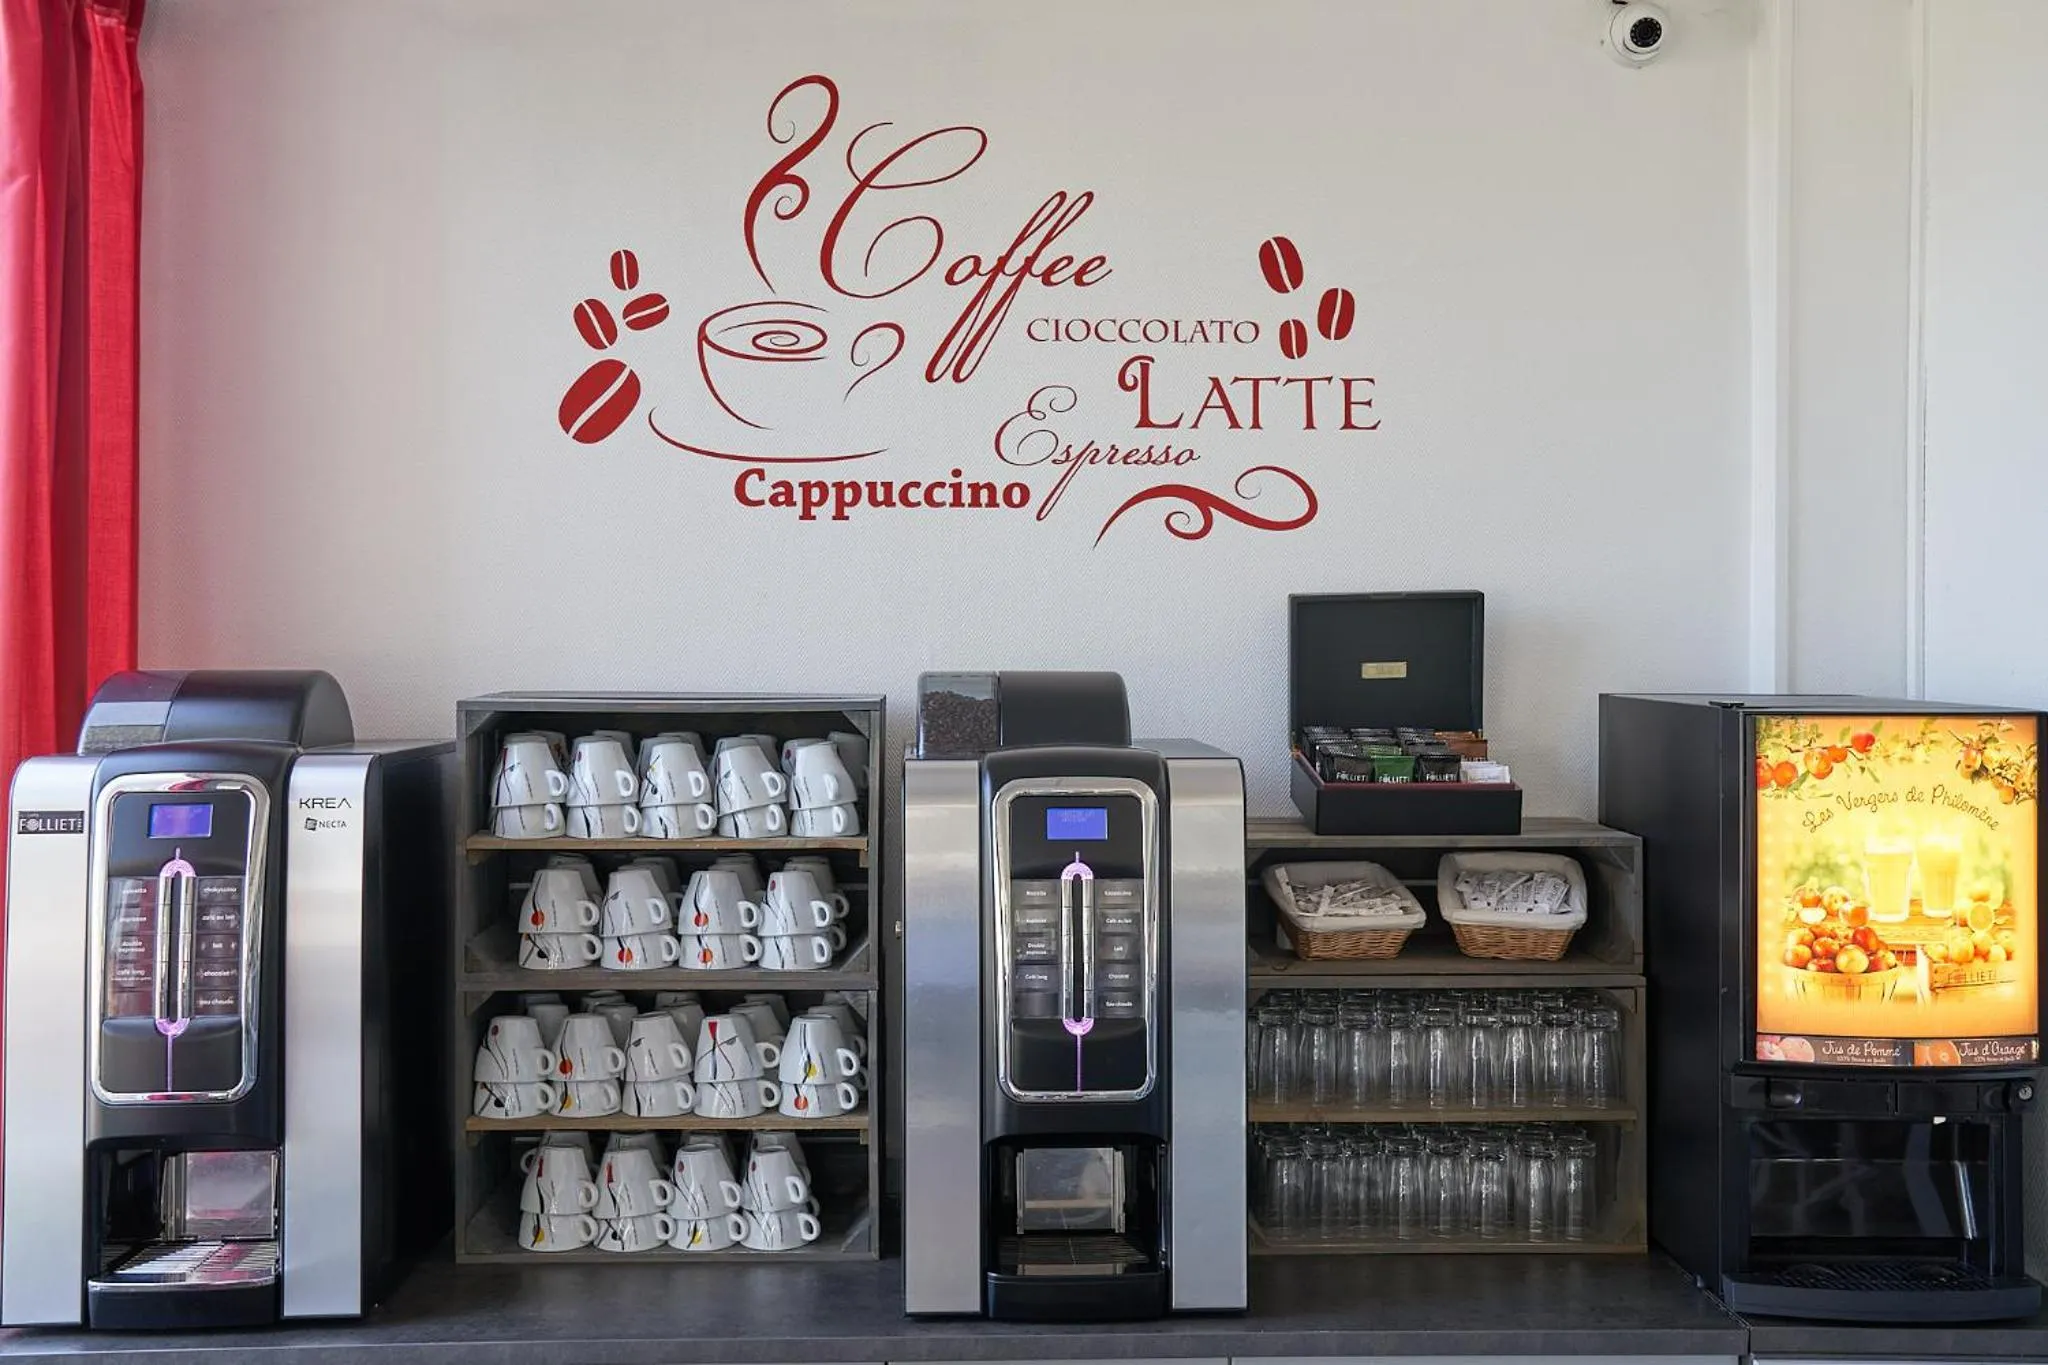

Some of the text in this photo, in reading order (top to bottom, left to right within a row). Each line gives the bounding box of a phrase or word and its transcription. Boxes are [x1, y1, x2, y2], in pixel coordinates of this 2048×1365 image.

[819, 122, 1113, 384] Coffee
[1026, 317, 1261, 344] CIOCCOLATO
[1117, 355, 1382, 431] LATTE
[994, 385, 1203, 522] Espresso
[734, 467, 1032, 523] Cappuccino
[1802, 807, 1834, 834] Les
[1836, 791, 1900, 813] Vergers
[1905, 786, 1925, 803] de
[1822, 1040, 1901, 1057] Jus de Pomme
[1959, 1042, 1979, 1056] Jus
